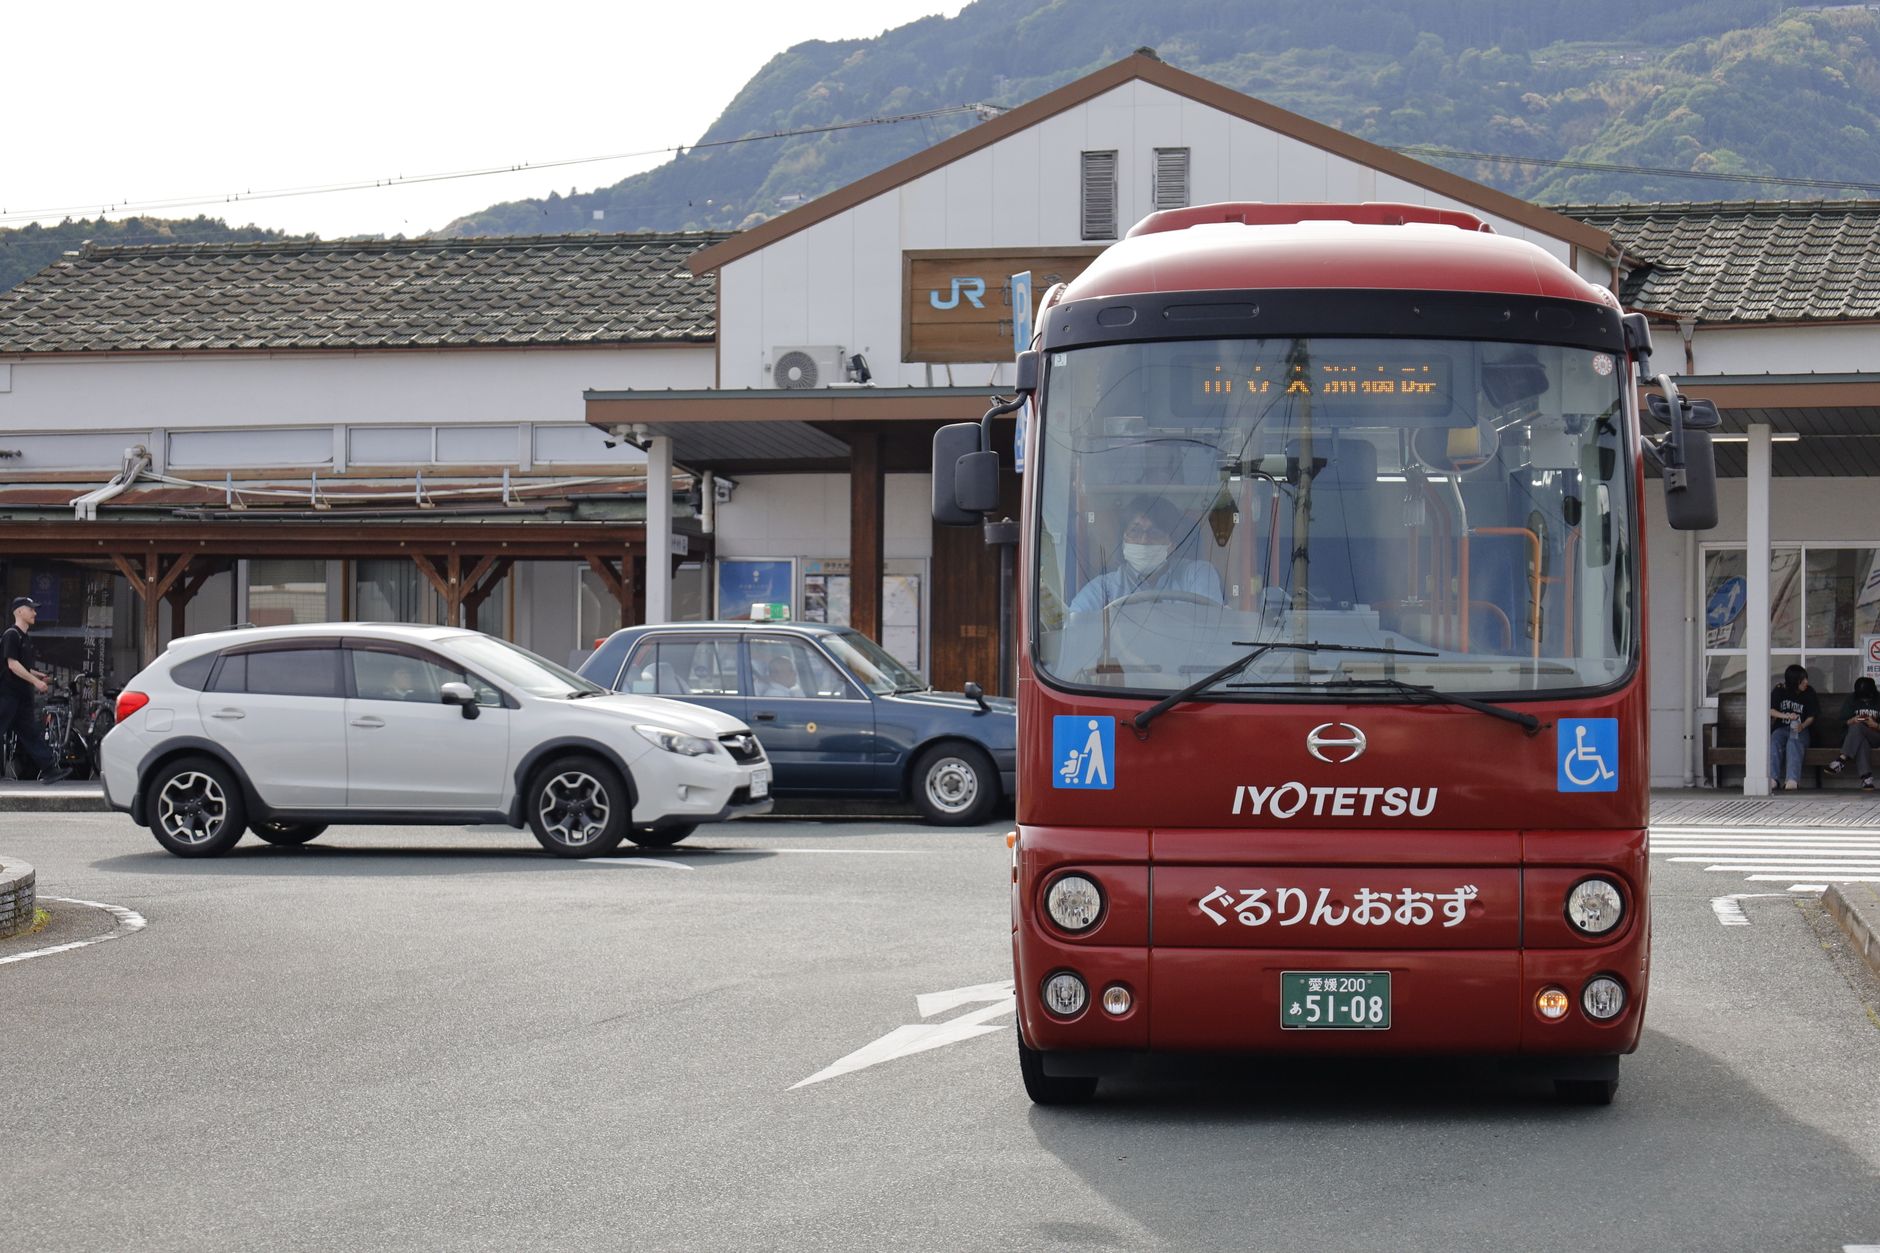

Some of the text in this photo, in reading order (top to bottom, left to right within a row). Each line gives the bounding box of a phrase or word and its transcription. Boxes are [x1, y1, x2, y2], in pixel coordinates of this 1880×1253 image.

[930, 277, 985, 310] JR
[1016, 282, 1027, 345] P
[1231, 781, 1438, 819] IYOTETSU
[1198, 884, 1479, 928] ぐるりんおおず
[1306, 995, 1383, 1023] 51-08
